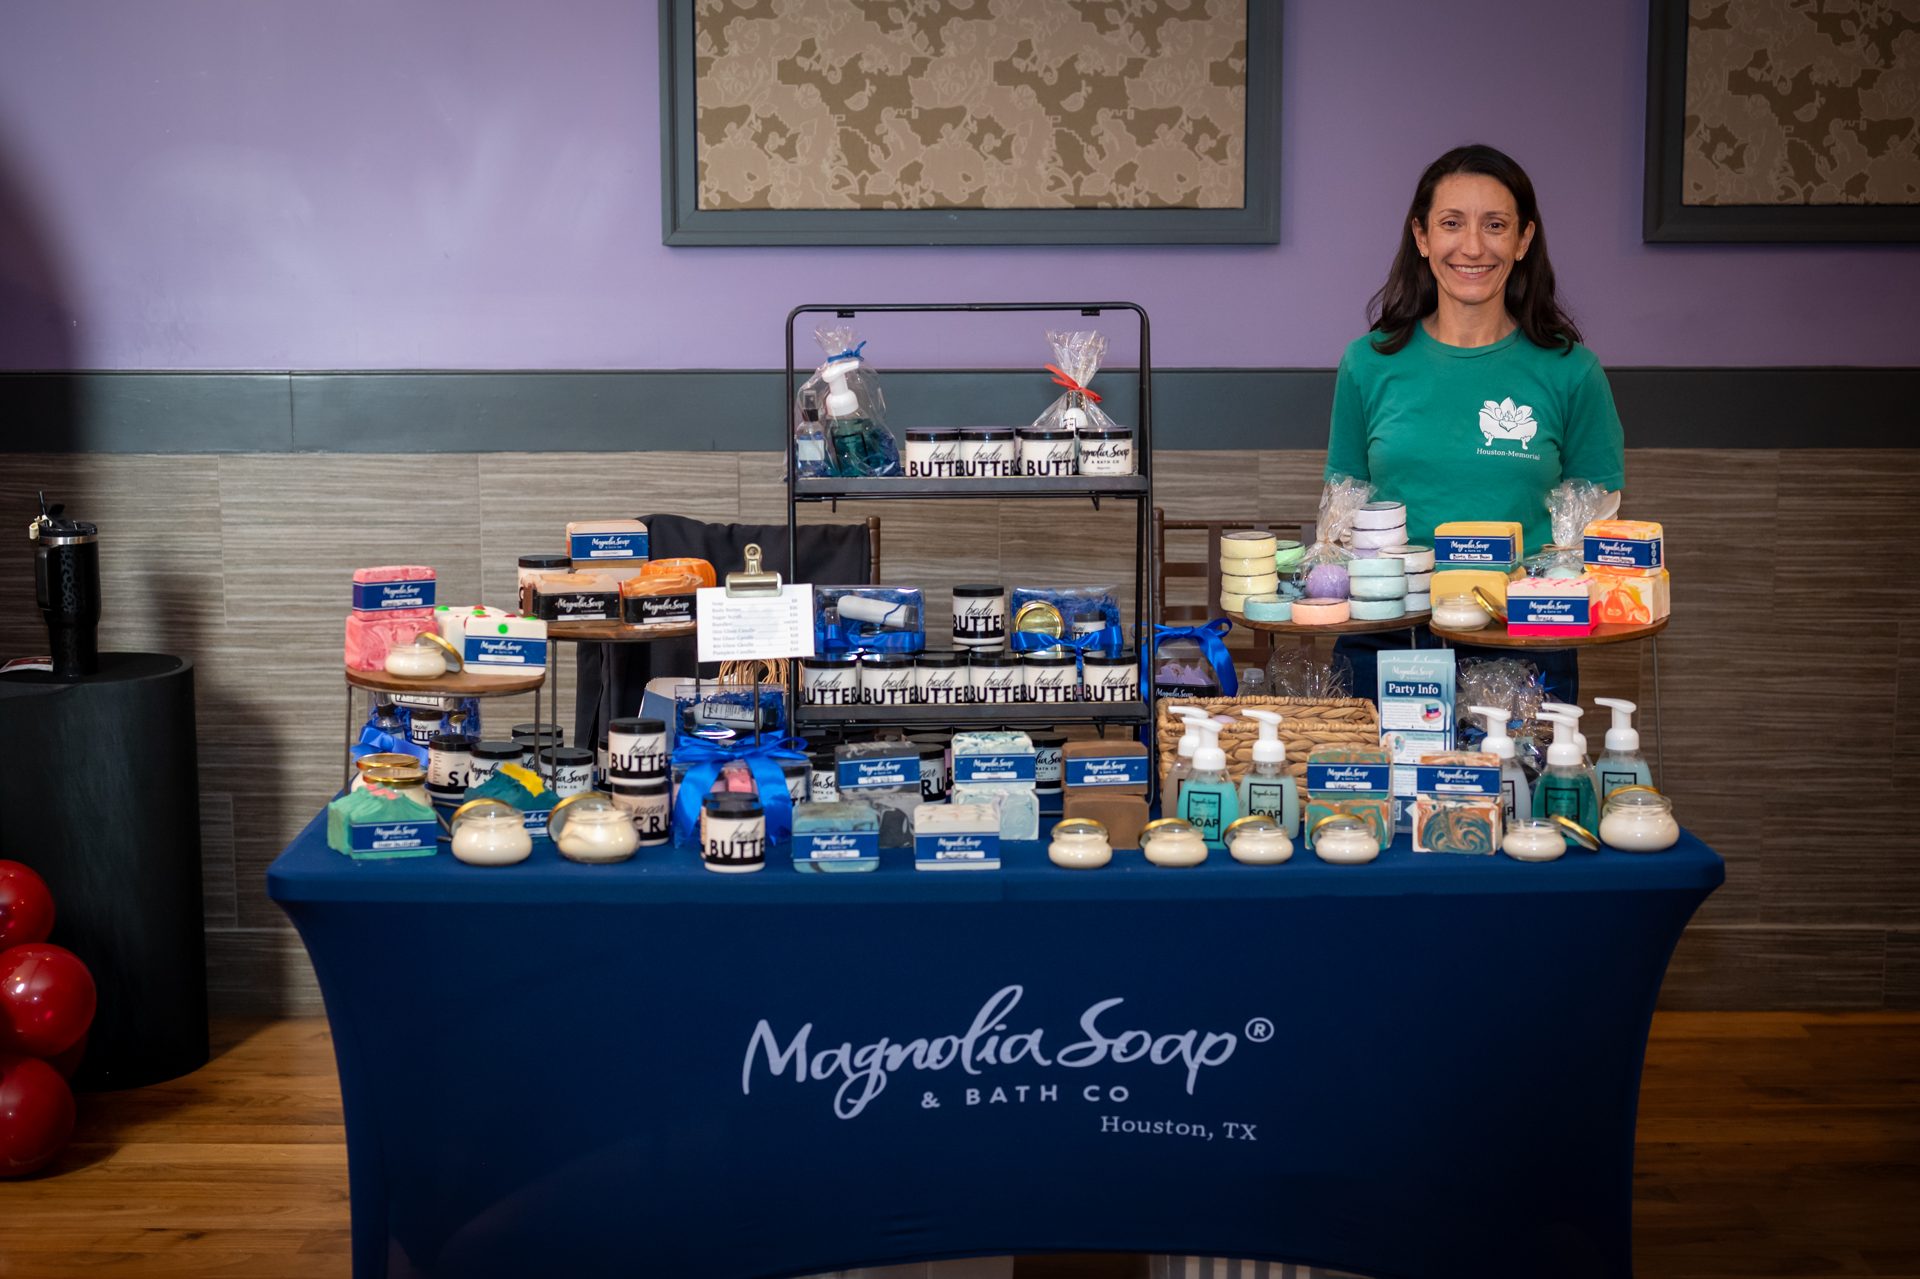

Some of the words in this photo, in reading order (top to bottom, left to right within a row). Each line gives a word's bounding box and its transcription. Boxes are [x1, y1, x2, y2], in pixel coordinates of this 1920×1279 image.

[972, 444, 1003, 461] body
[1079, 442, 1109, 464] agnolia
[1110, 443, 1130, 461] Soap
[1476, 447, 1541, 461] Houston-Memorial
[910, 461, 960, 477] BUTTE
[1027, 460, 1075, 476] BUTTE
[966, 600, 994, 617] body
[813, 672, 842, 689] body
[882, 672, 909, 688] body
[926, 671, 955, 688] body
[984, 670, 1014, 687] body
[1035, 670, 1064, 686] body
[1102, 669, 1132, 686] body
[865, 687, 916, 704] BUTTE
[1086, 684, 1139, 702] BUTTE
[1388, 683, 1415, 696] Party
[1418, 684, 1439, 695] Info
[611, 753, 668, 772] BUTTE
[567, 770, 590, 786] Soap
[1188, 817, 1220, 828] SOAP
[711, 840, 765, 859] BUTTE
[742, 984, 1051, 1119] Magnolia
[1057, 997, 1237, 1095] Soap
[920, 1091, 941, 1108] &
[965, 1084, 1058, 1106] BATH
[1083, 1084, 1130, 1102] CO
[1099, 1115, 1215, 1140] Houston,
[1223, 1121, 1258, 1142] TX
